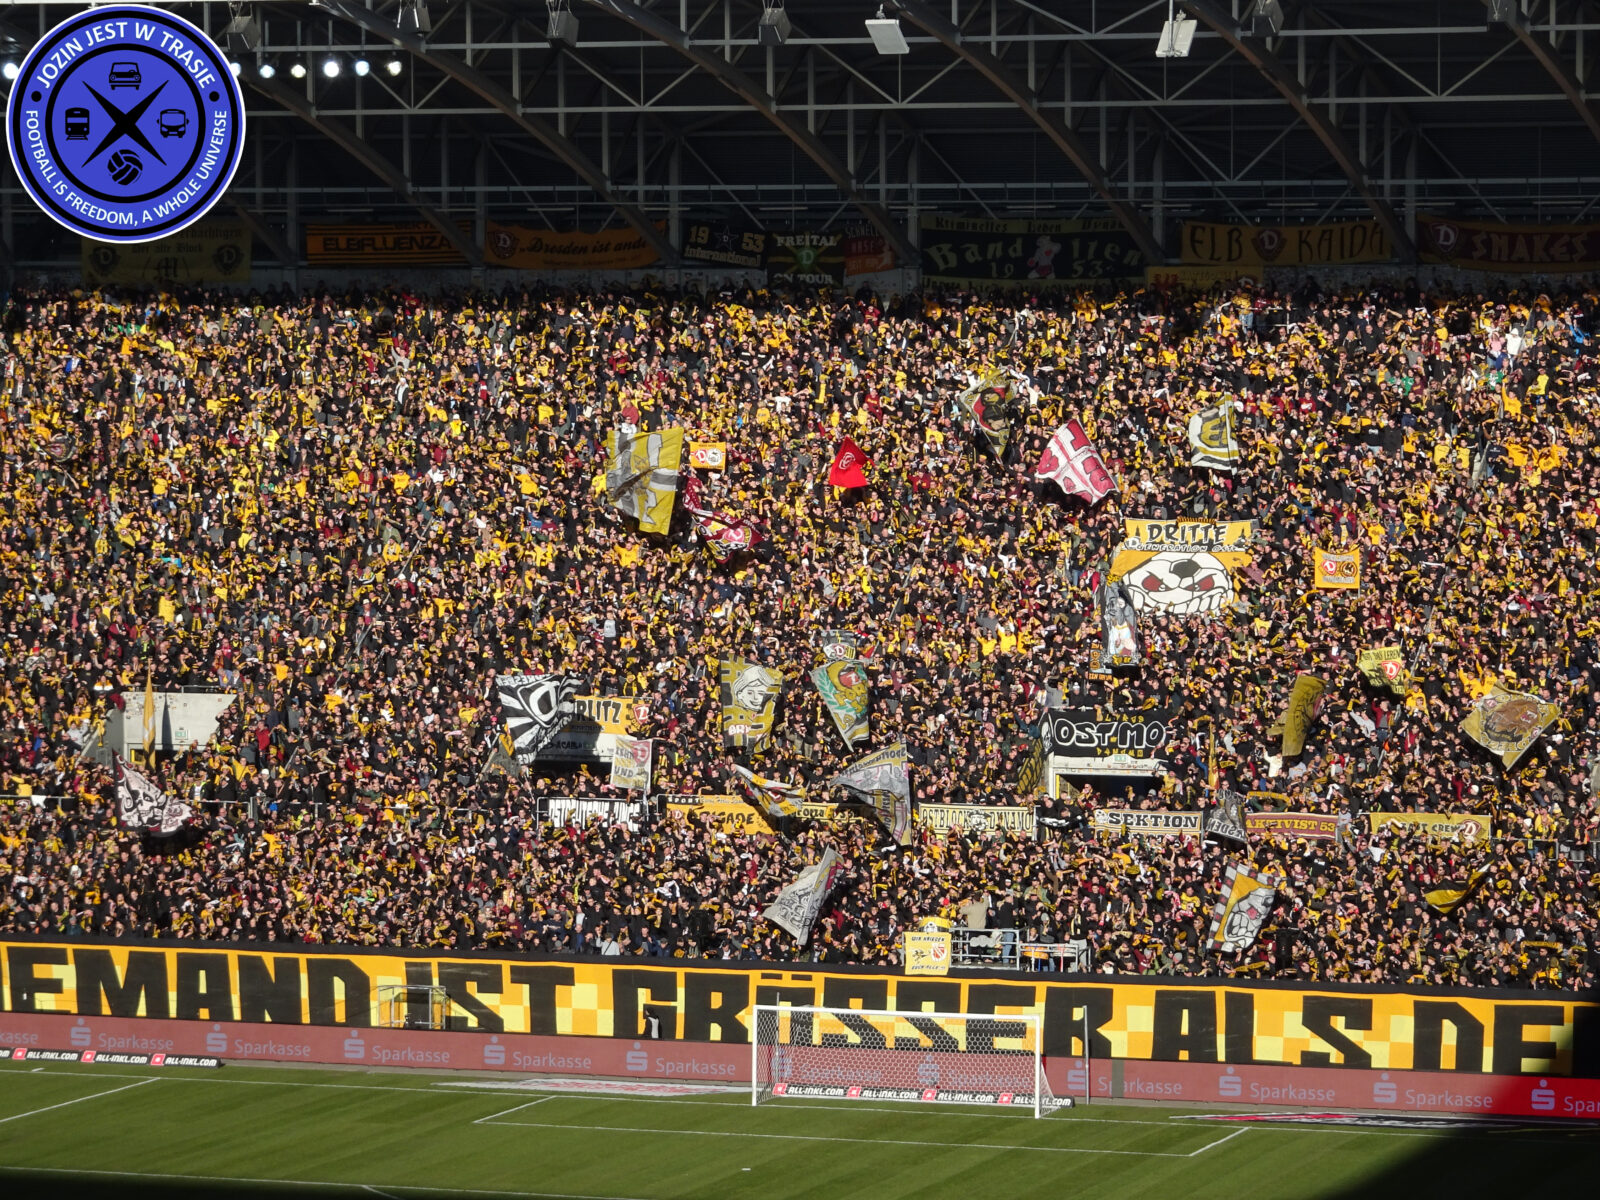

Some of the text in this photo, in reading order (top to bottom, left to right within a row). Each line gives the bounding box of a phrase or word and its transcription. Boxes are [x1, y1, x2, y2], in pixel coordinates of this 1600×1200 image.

[323, 236, 451, 252] ELBFLUENZA
[688, 225, 710, 244] 19
[741, 232, 766, 253] 53
[776, 234, 837, 248] FREITAL
[1190, 225, 1243, 262] ELB
[1298, 222, 1384, 263] KAIDA
[1146, 523, 1227, 544] DRITTE
[575, 699, 622, 724] RLITZ
[1055, 718, 1170, 749] OSTMO
[1108, 812, 1198, 828] SEKTION
[1319, 821, 1336, 832] 53
[0, 943, 371, 1028] EMAND
[404, 960, 575, 1037] IST
[1151, 989, 1373, 1069] ALS
[1412, 999, 1600, 1078] DE
[0, 1032, 38, 1045] kasse
[98, 1032, 174, 1051] Sparkasse
[234, 1039, 311, 1058] Sparkasse
[372, 1045, 450, 1064] Sparkasse
[512, 1051, 592, 1070] Sparkasse
[655, 1057, 736, 1076] Sparkasse
[1250, 1082, 1335, 1102] Sparkasse
[1405, 1089, 1493, 1108] Sparkasse
[1563, 1096, 1600, 1115] Spar
